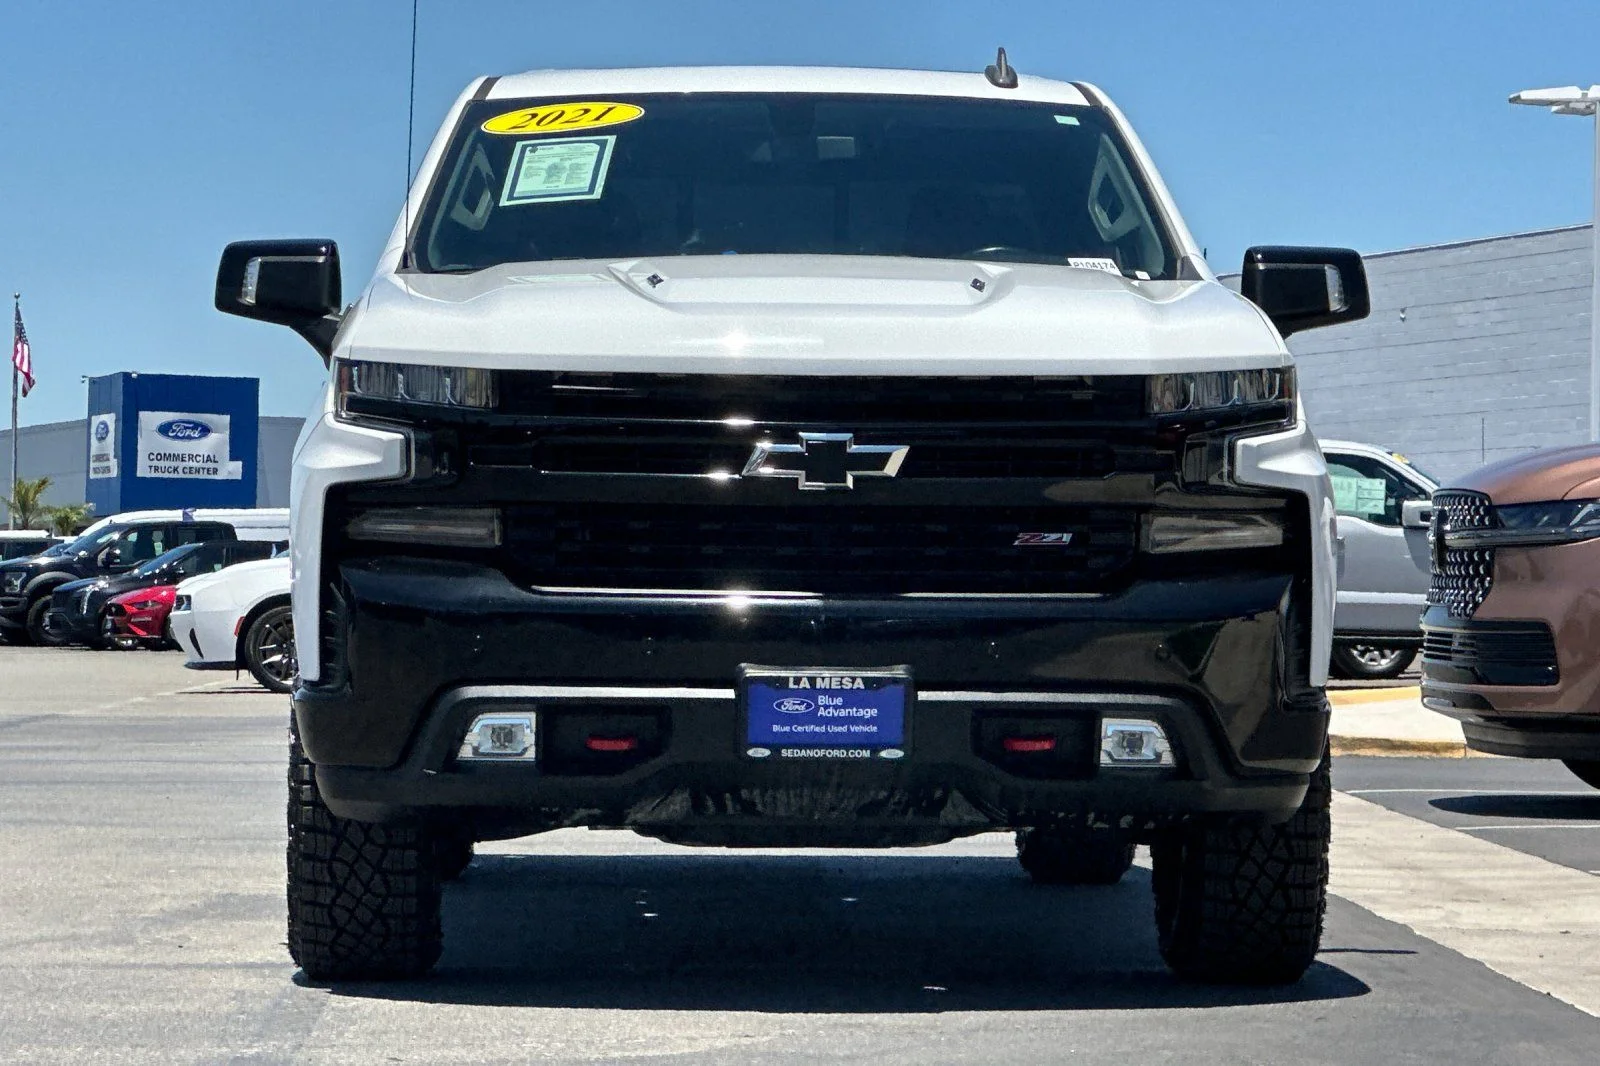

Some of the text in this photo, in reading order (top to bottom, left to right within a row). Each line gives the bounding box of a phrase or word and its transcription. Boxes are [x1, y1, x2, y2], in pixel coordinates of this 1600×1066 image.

[506, 105, 617, 130] 2021
[168, 422, 202, 437] Ford
[147, 452, 219, 464] COMMERCIAL
[148, 465, 219, 476] TRUCK CENTER
[1013, 532, 1073, 545] Z71
[788, 677, 865, 690] LA MESA
[780, 699, 807, 711] Ford
[817, 695, 843, 706] Blue
[817, 707, 878, 719] Advantage
[772, 724, 878, 733] Blue Certified Used Vehicle
[781, 748, 871, 758] SEDANOFORD.COM
